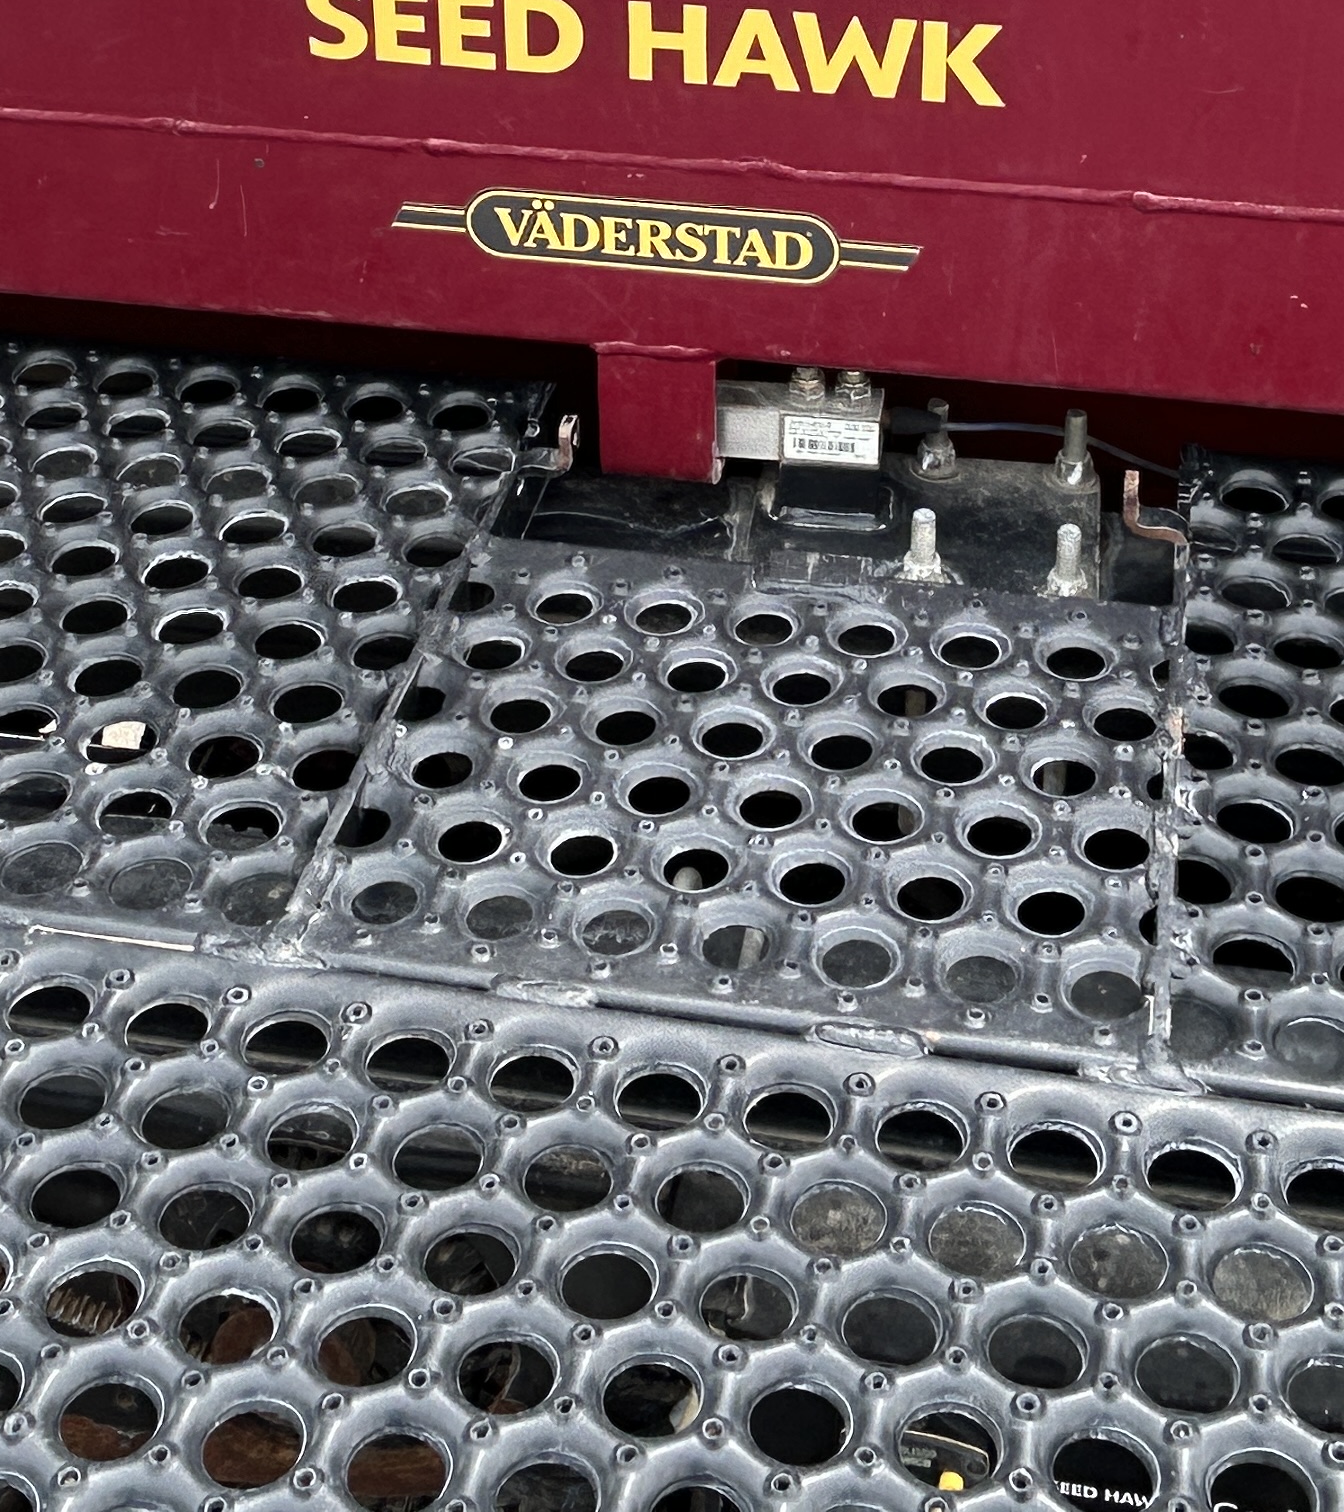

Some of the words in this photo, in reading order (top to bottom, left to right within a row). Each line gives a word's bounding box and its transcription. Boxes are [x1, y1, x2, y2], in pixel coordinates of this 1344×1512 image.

[627, 0, 1006, 108] HAWK
[493, 198, 814, 271] VÄDERSTAD
[1104, 1488, 1150, 1509] HAW
